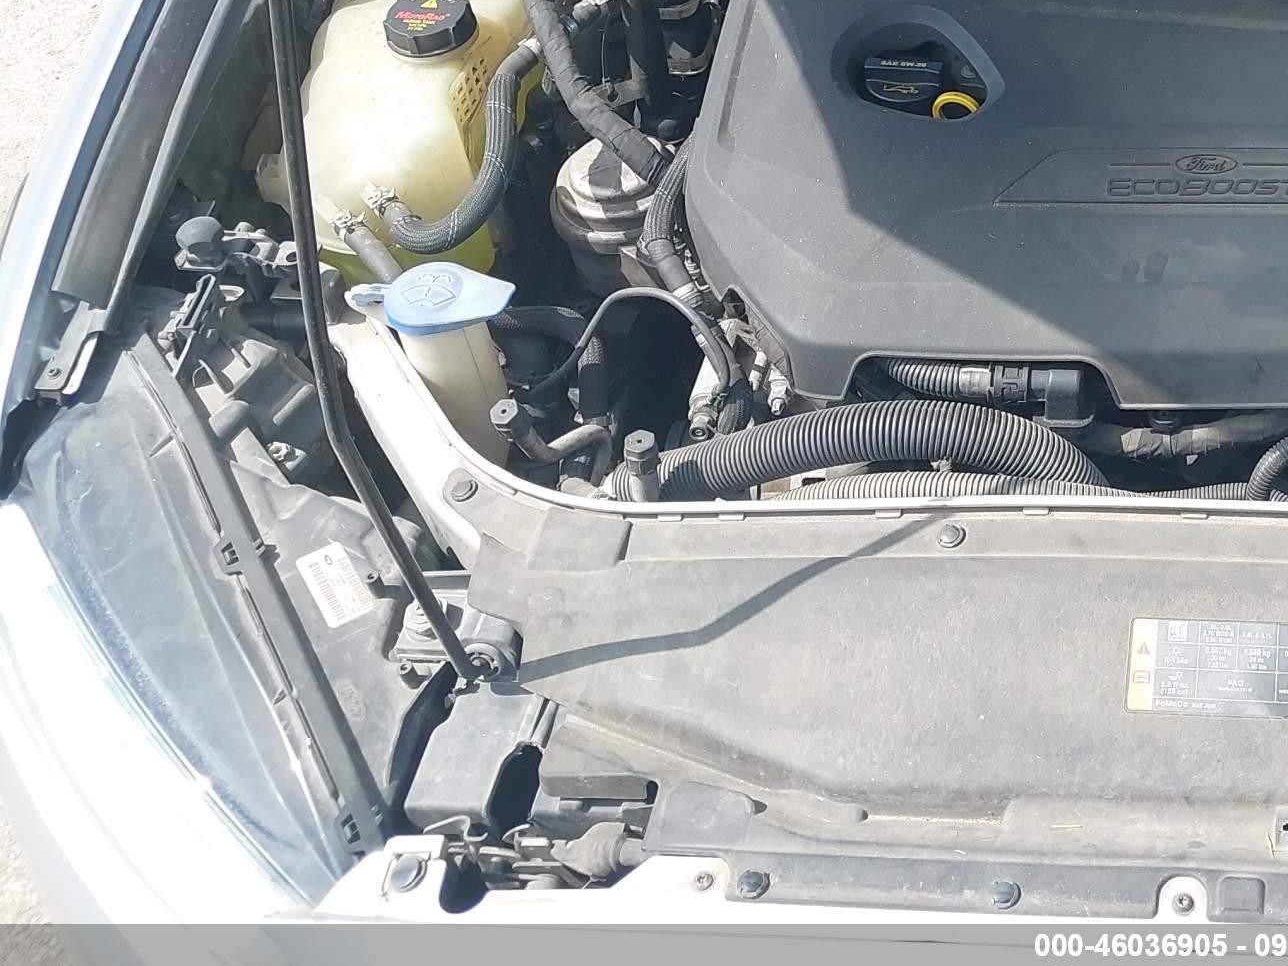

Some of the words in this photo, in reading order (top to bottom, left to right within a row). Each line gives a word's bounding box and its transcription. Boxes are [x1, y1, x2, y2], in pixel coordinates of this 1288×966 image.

[1185, 156, 1227, 172] Ford
[1227, 679, 1244, 687] PAG
[1156, 700, 1188, 708] FoMoCo
